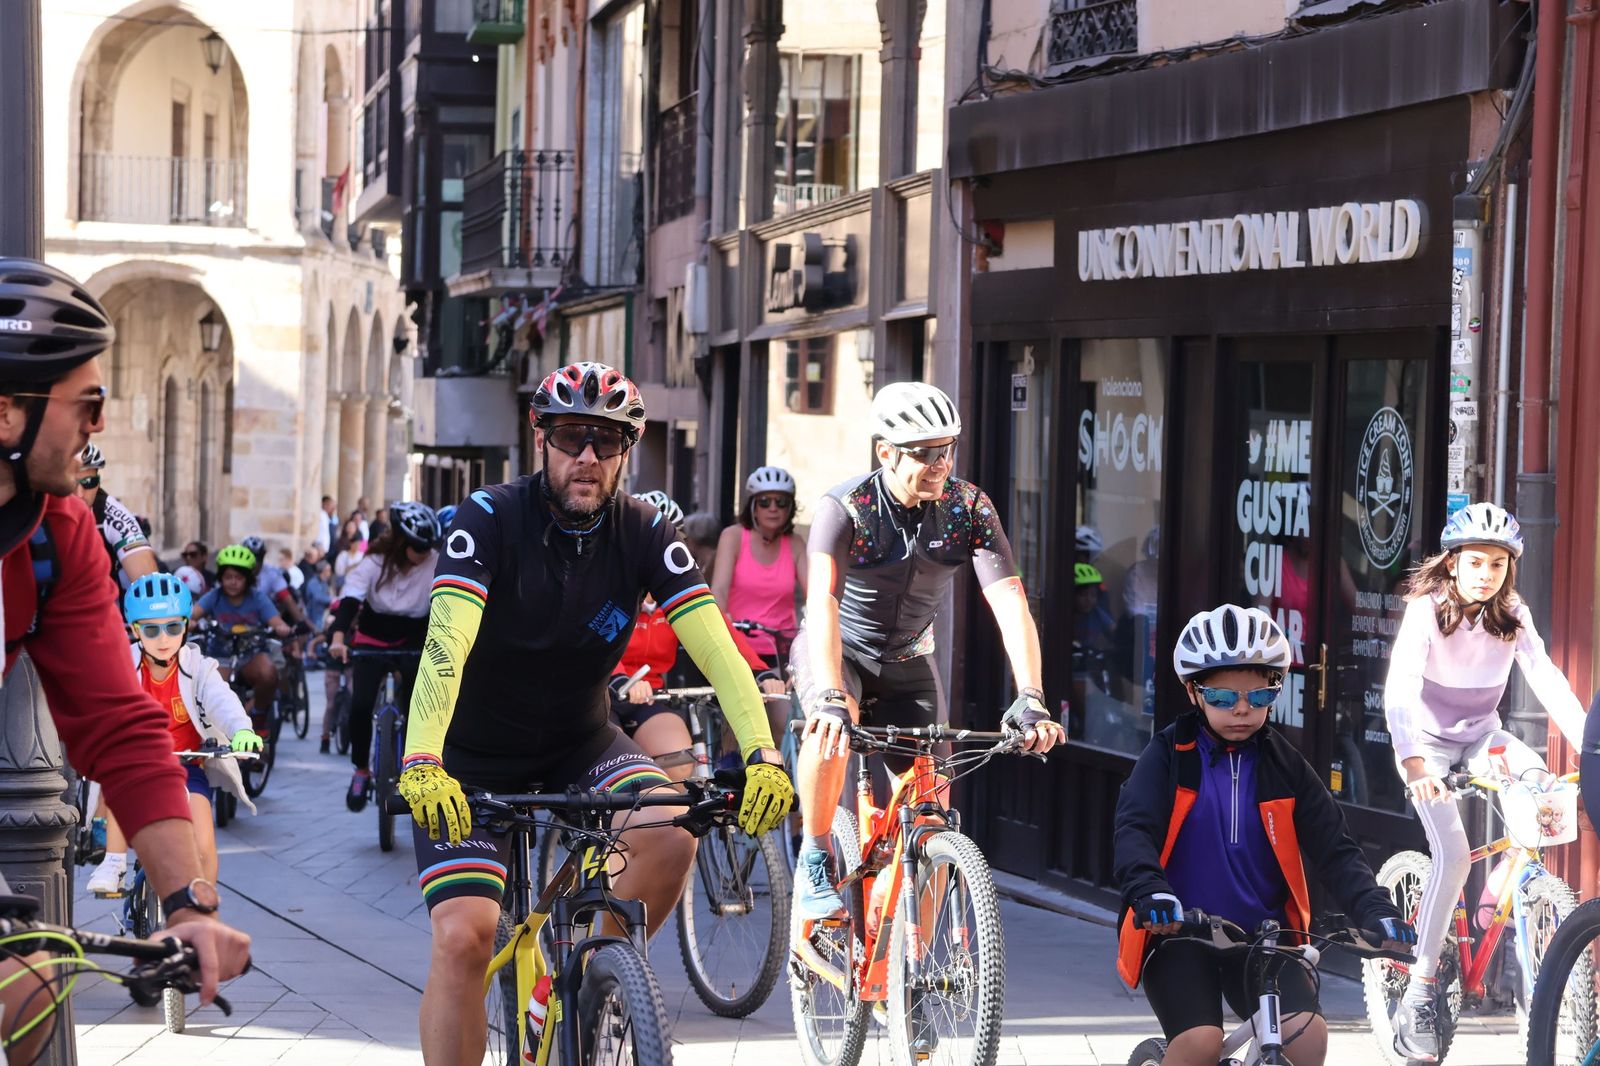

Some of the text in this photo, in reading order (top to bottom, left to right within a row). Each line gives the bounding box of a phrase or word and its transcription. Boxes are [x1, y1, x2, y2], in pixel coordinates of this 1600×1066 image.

[1078, 199, 1420, 282] UNCONVENTIONAL WORLD
[0, 319, 32, 331] IRO
[1079, 409, 1163, 478] SHOCK
[1264, 420, 1312, 473] #ME
[1360, 443, 1371, 477] ICE
[1368, 413, 1396, 445] CREAM
[1396, 423, 1412, 481] ZONE
[1237, 479, 1311, 537] GUSTA
[1245, 540, 1284, 598] CUI
[436, 665, 456, 678] EL
